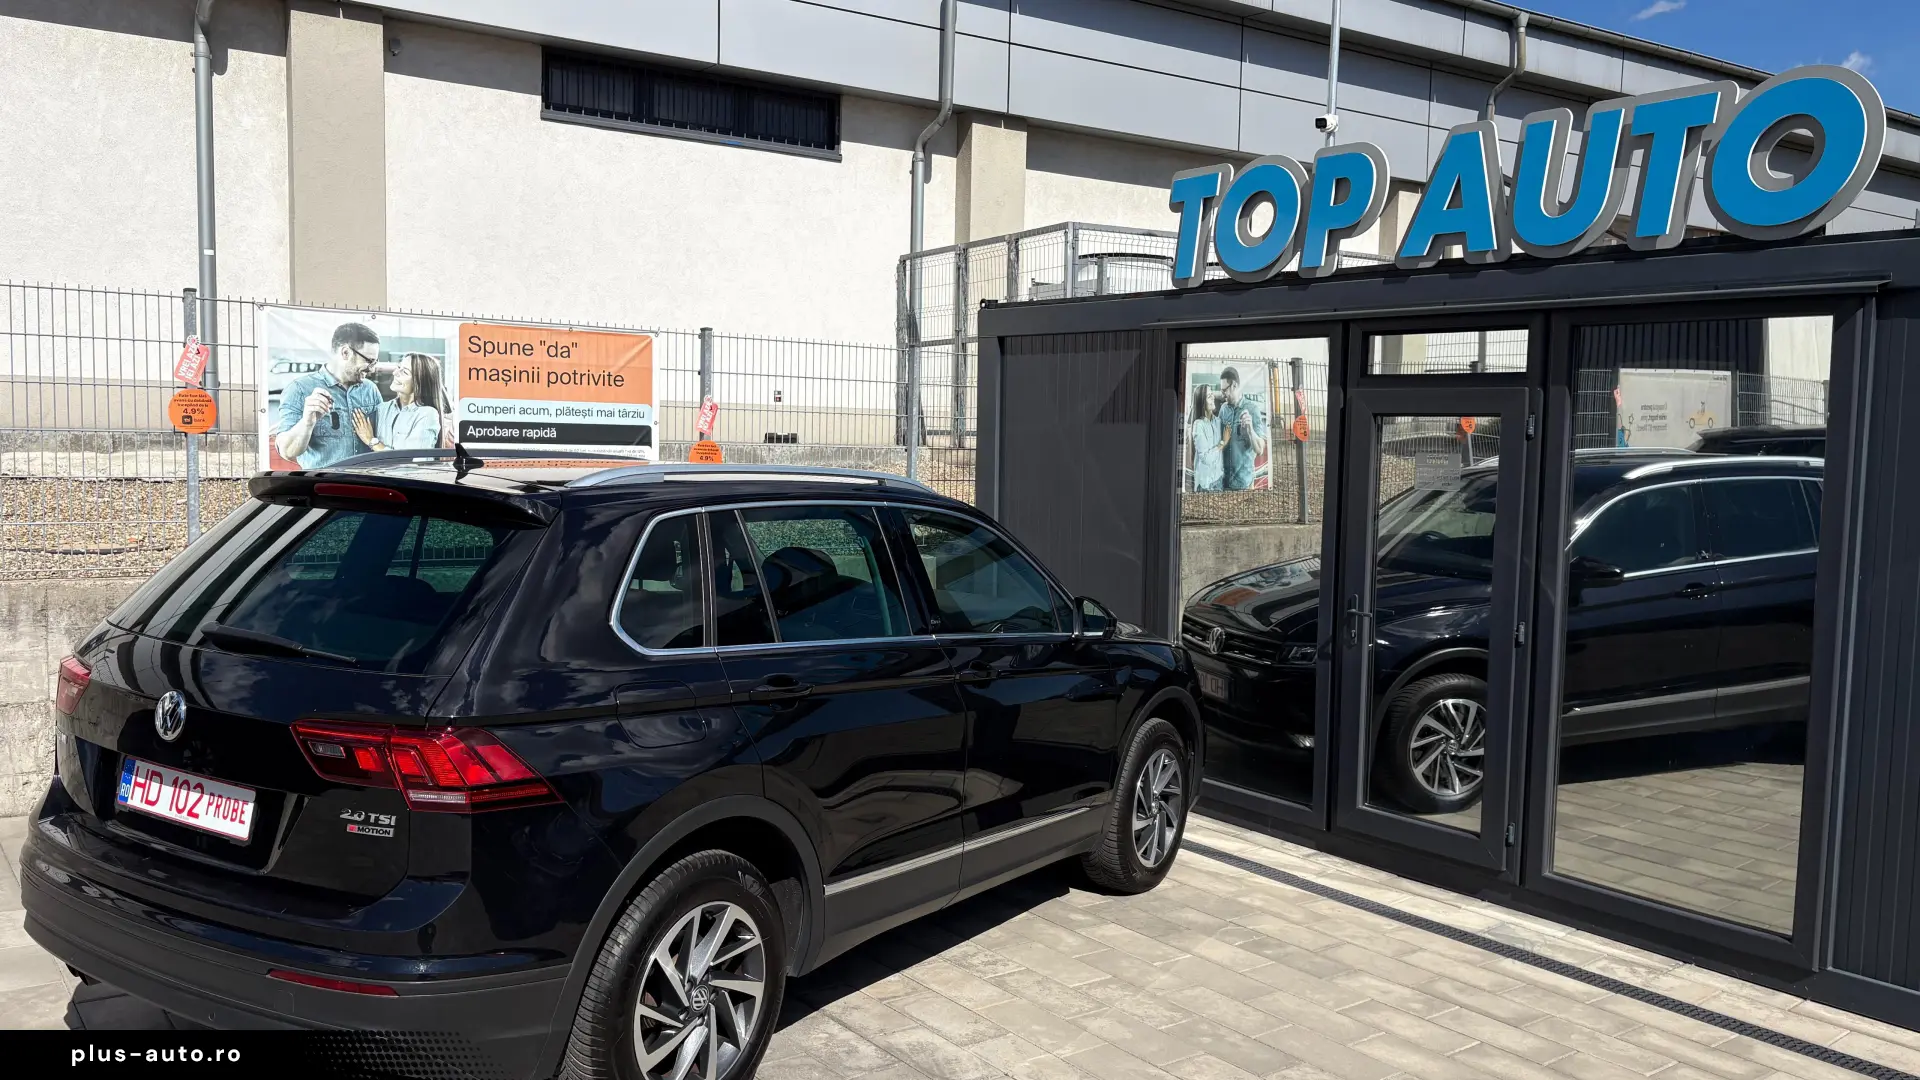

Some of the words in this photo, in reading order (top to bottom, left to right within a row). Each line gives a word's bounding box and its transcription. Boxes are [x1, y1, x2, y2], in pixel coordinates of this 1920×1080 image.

[1171, 142, 1389, 286] TOP
[1396, 64, 1886, 270] AUTO
[468, 335, 534, 357] Spune
[540, 339, 578, 358] "da"
[468, 365, 540, 387] mașinii
[547, 369, 625, 388] potrivite
[467, 403, 516, 416] Cumperi
[518, 406, 553, 418] acum,
[555, 406, 594, 419] plătești
[596, 408, 615, 418] mai
[618, 408, 645, 419] târziu
[466, 425, 520, 439] Aprobare
[522, 427, 557, 440] rapidă
[120, 782, 131, 798] RO
[131, 765, 164, 807] HD
[169, 776, 205, 820] 102
[205, 791, 249, 825] PROBE
[367, 812, 397, 826] TSI
